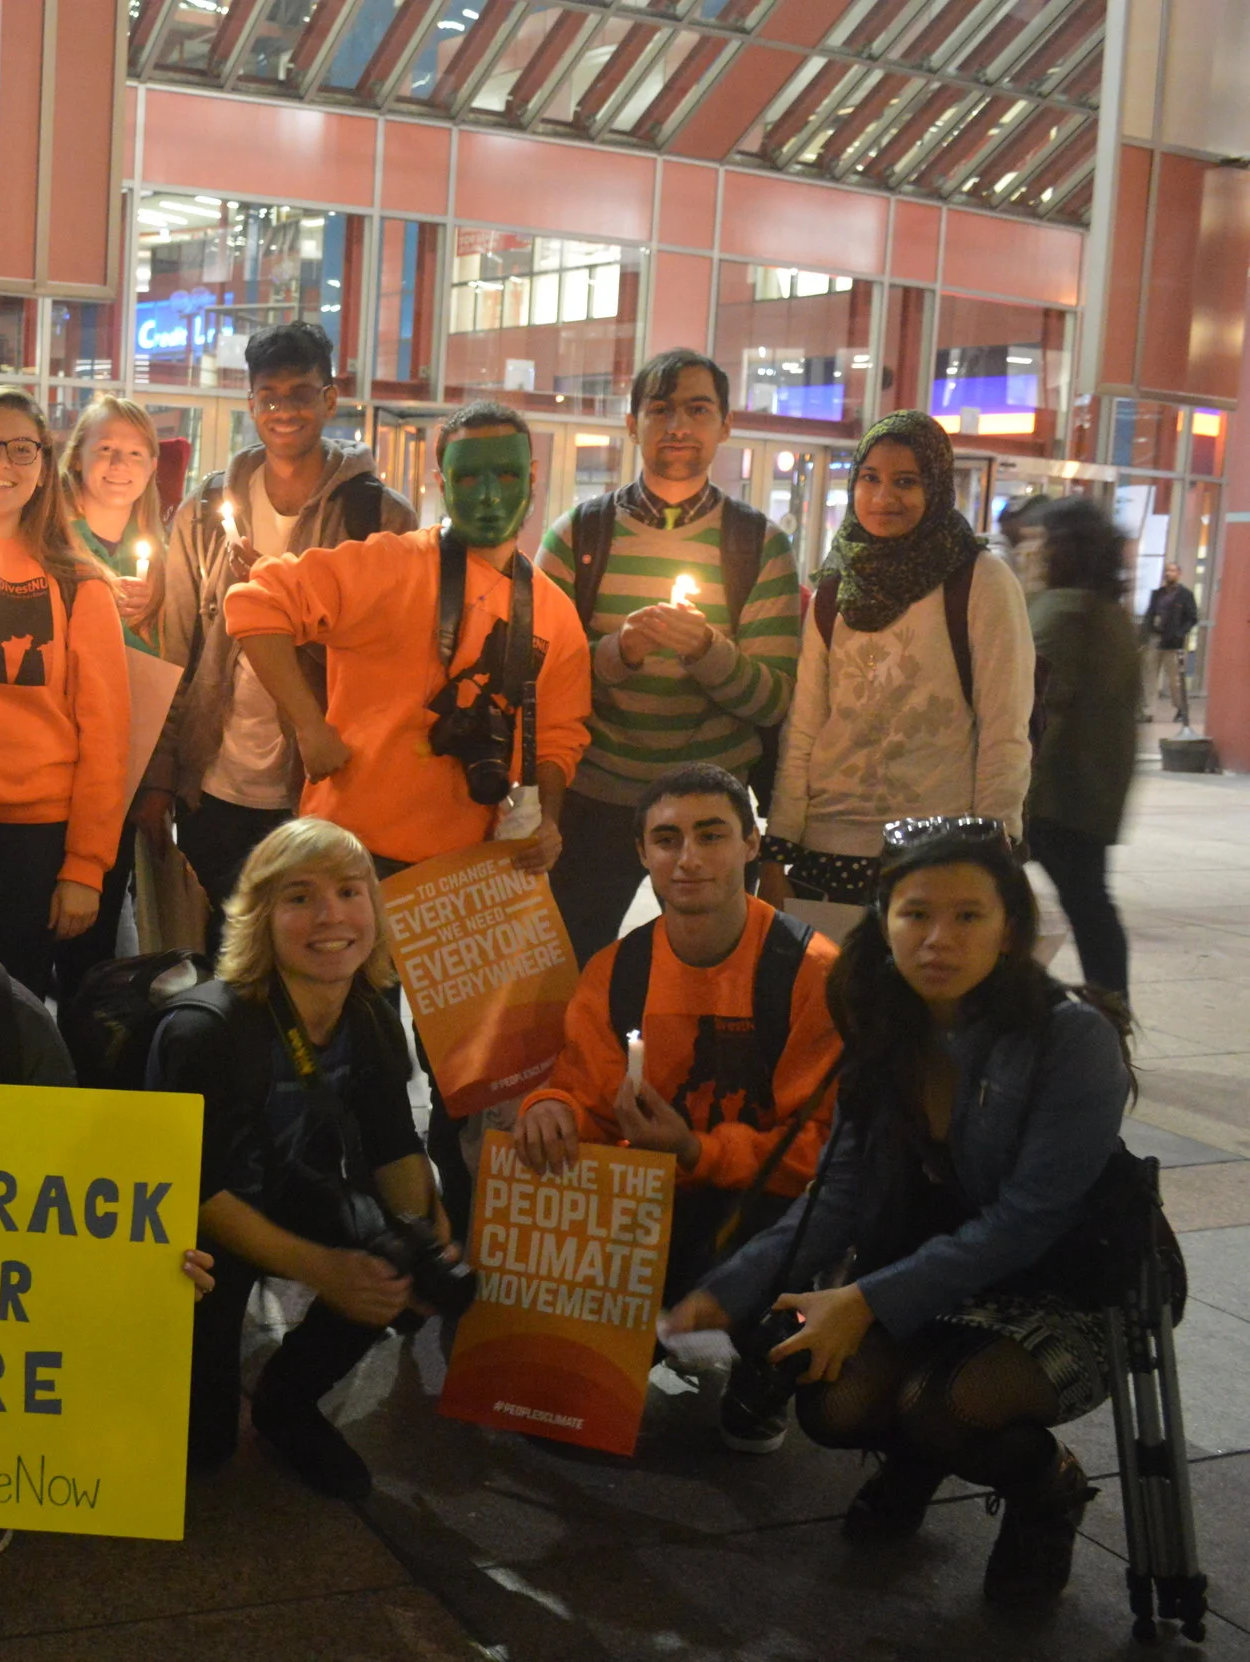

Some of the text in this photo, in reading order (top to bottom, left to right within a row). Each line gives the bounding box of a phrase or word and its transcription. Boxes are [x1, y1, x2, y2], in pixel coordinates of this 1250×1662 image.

[388, 868, 538, 942] EVERYTHING
[416, 859, 497, 900] TO CHANGE
[405, 907, 558, 990] EVERYONE
[436, 907, 507, 943] WE NEED
[414, 940, 567, 1016] EVERYWHERE
[490, 1146, 532, 1181] WE
[609, 1162, 666, 1201] THE
[484, 1178, 663, 1246] PEOPLES
[479, 1224, 659, 1295] CLIMATE
[476, 1269, 651, 1331] MOVEMENT!
